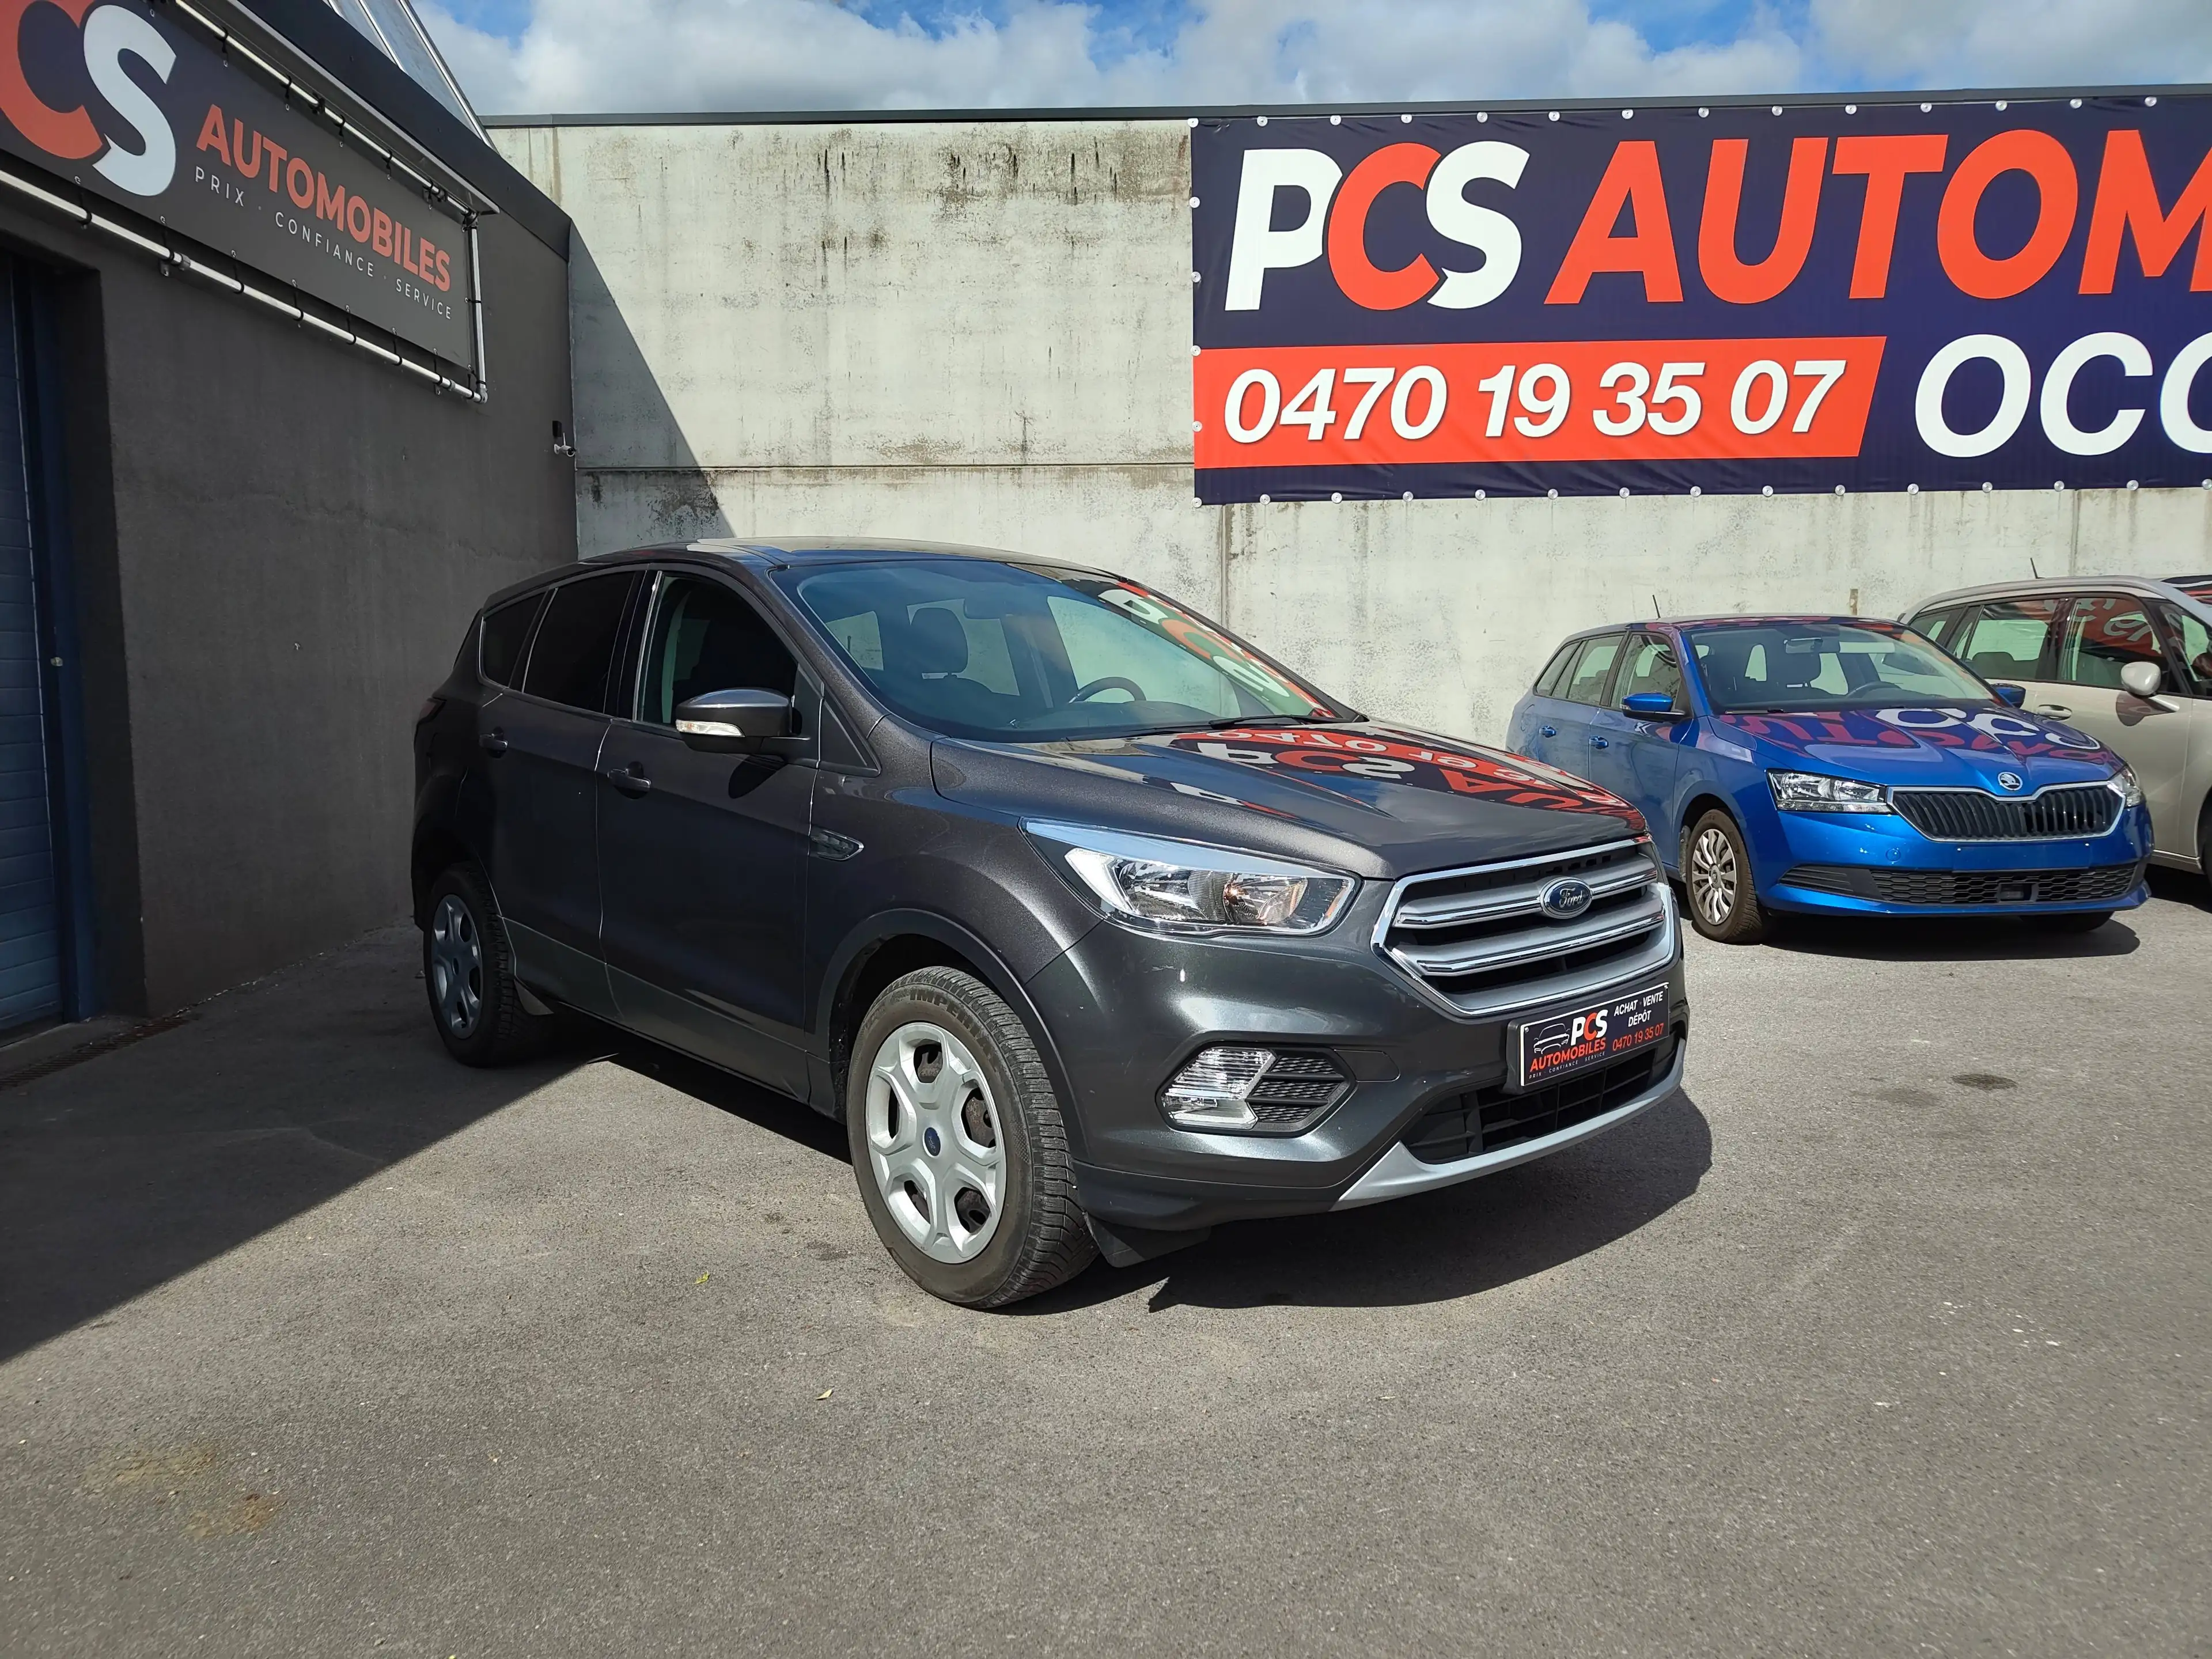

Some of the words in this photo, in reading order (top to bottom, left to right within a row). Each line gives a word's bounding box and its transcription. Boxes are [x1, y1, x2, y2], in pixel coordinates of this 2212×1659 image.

[196, 104, 451, 292] AUTOMOBILES
[195, 166, 245, 207] PRIX
[275, 211, 375, 278] CONFIANCE
[396, 278, 452, 320] SERVICE
[1225, 141, 1530, 310] PCS
[1224, 365, 1448, 444] 0470
[1477, 362, 1571, 438] 19
[1592, 362, 1706, 437] 35
[1730, 359, 1847, 435] 07
[1558, 887, 1584, 908] Ford
[1613, 999, 1638, 1017] ACHAT
[1643, 990, 1664, 1007] VENTE
[1628, 1009, 1652, 1027] DÉPÔT
[1570, 1009, 1608, 1046] PCS
[1612, 1034, 1632, 1051] 0470
[1634, 1030, 1643, 1044] 19
[1645, 1026, 1654, 1040] 35
[1654, 1022, 1664, 1036] 07
[1529, 1037, 1606, 1073] AUTOMOBILES
[1548, 1059, 1578, 1073] CONFIANCE
[1585, 1051, 1605, 1062] SERVICE
